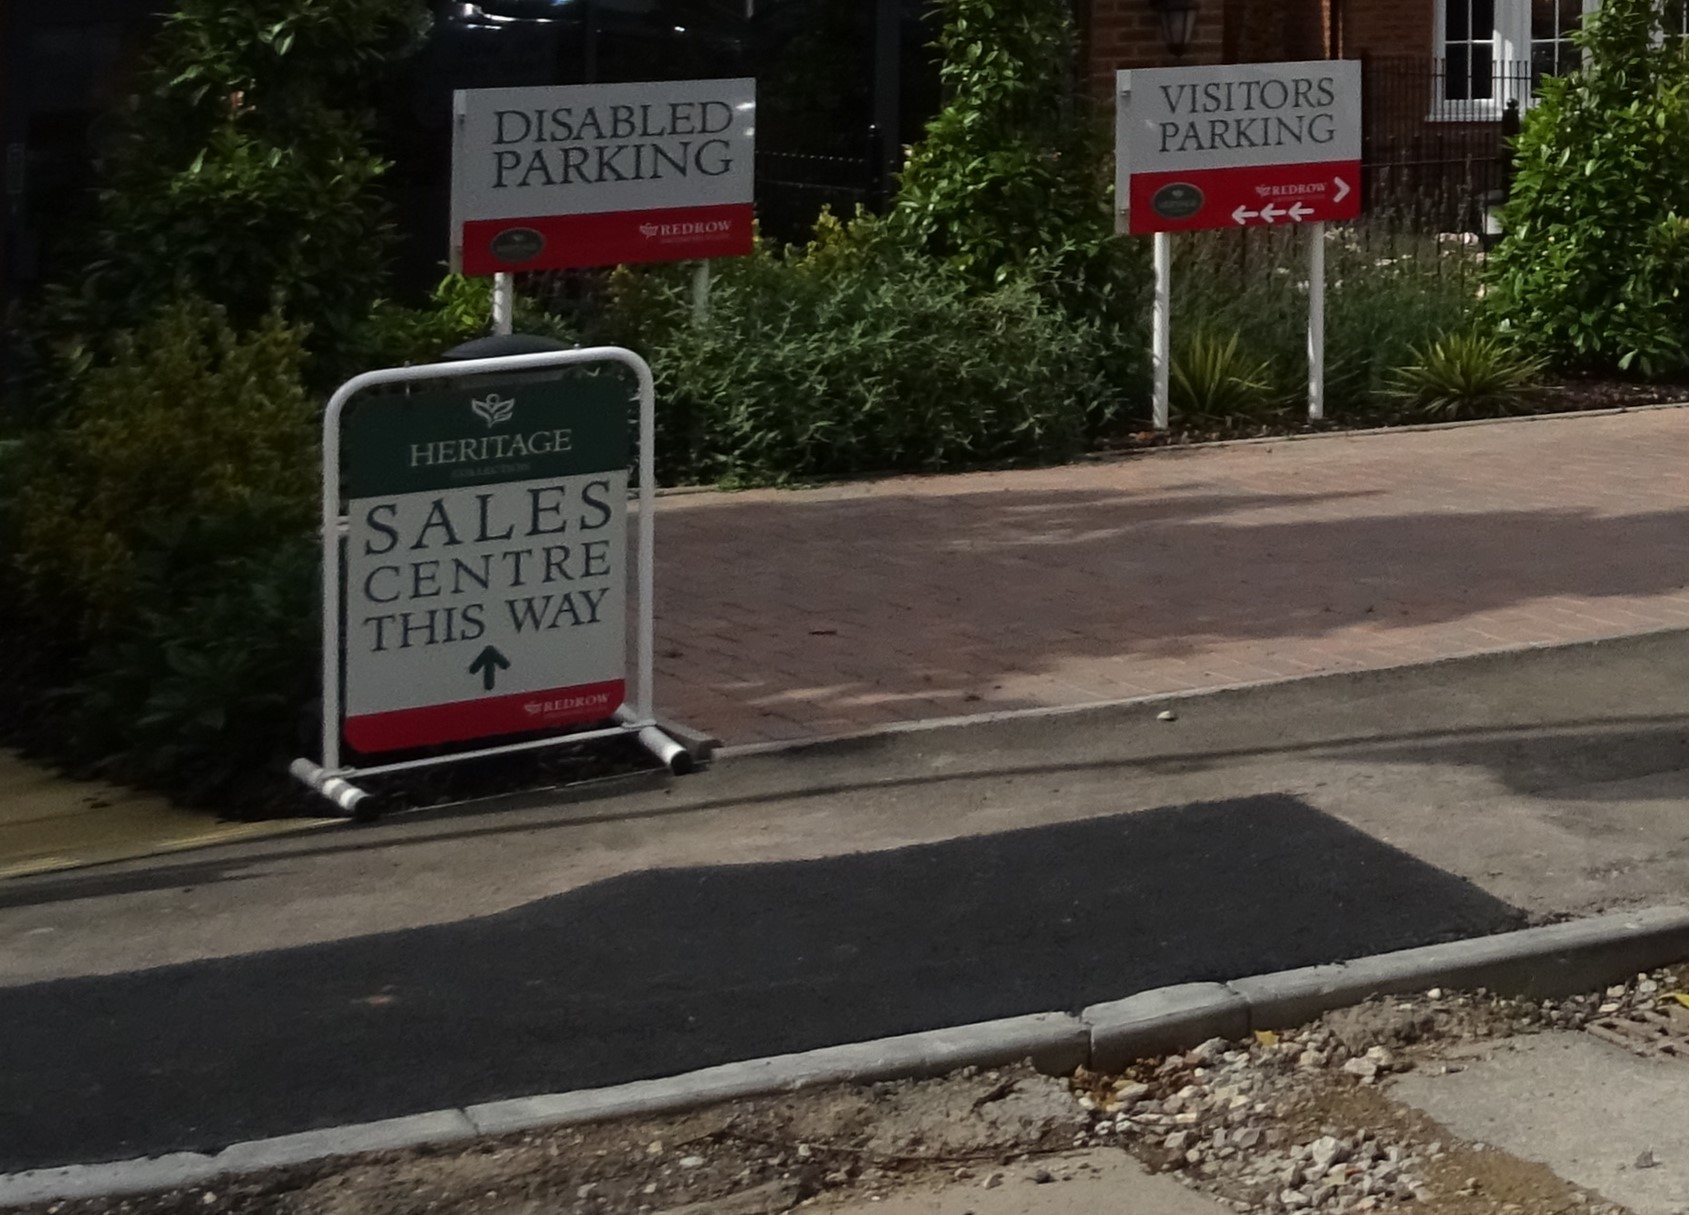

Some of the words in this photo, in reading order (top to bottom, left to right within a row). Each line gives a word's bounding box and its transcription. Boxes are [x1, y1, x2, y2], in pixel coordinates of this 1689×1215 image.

[1159, 77, 1335, 115] VISITORS
[491, 101, 734, 145] DISABLED
[1159, 113, 1336, 153] PARKING
[491, 139, 733, 188] PARKING
[1271, 182, 1327, 196] REDROW
[660, 219, 733, 236] REDROW
[410, 428, 573, 467] HERITAGE
[365, 480, 613, 555] SALES
[364, 539, 612, 604] CENTRE
[363, 603, 486, 653] THIS
[505, 587, 611, 634] WAY
[543, 691, 611, 712] REDROW
